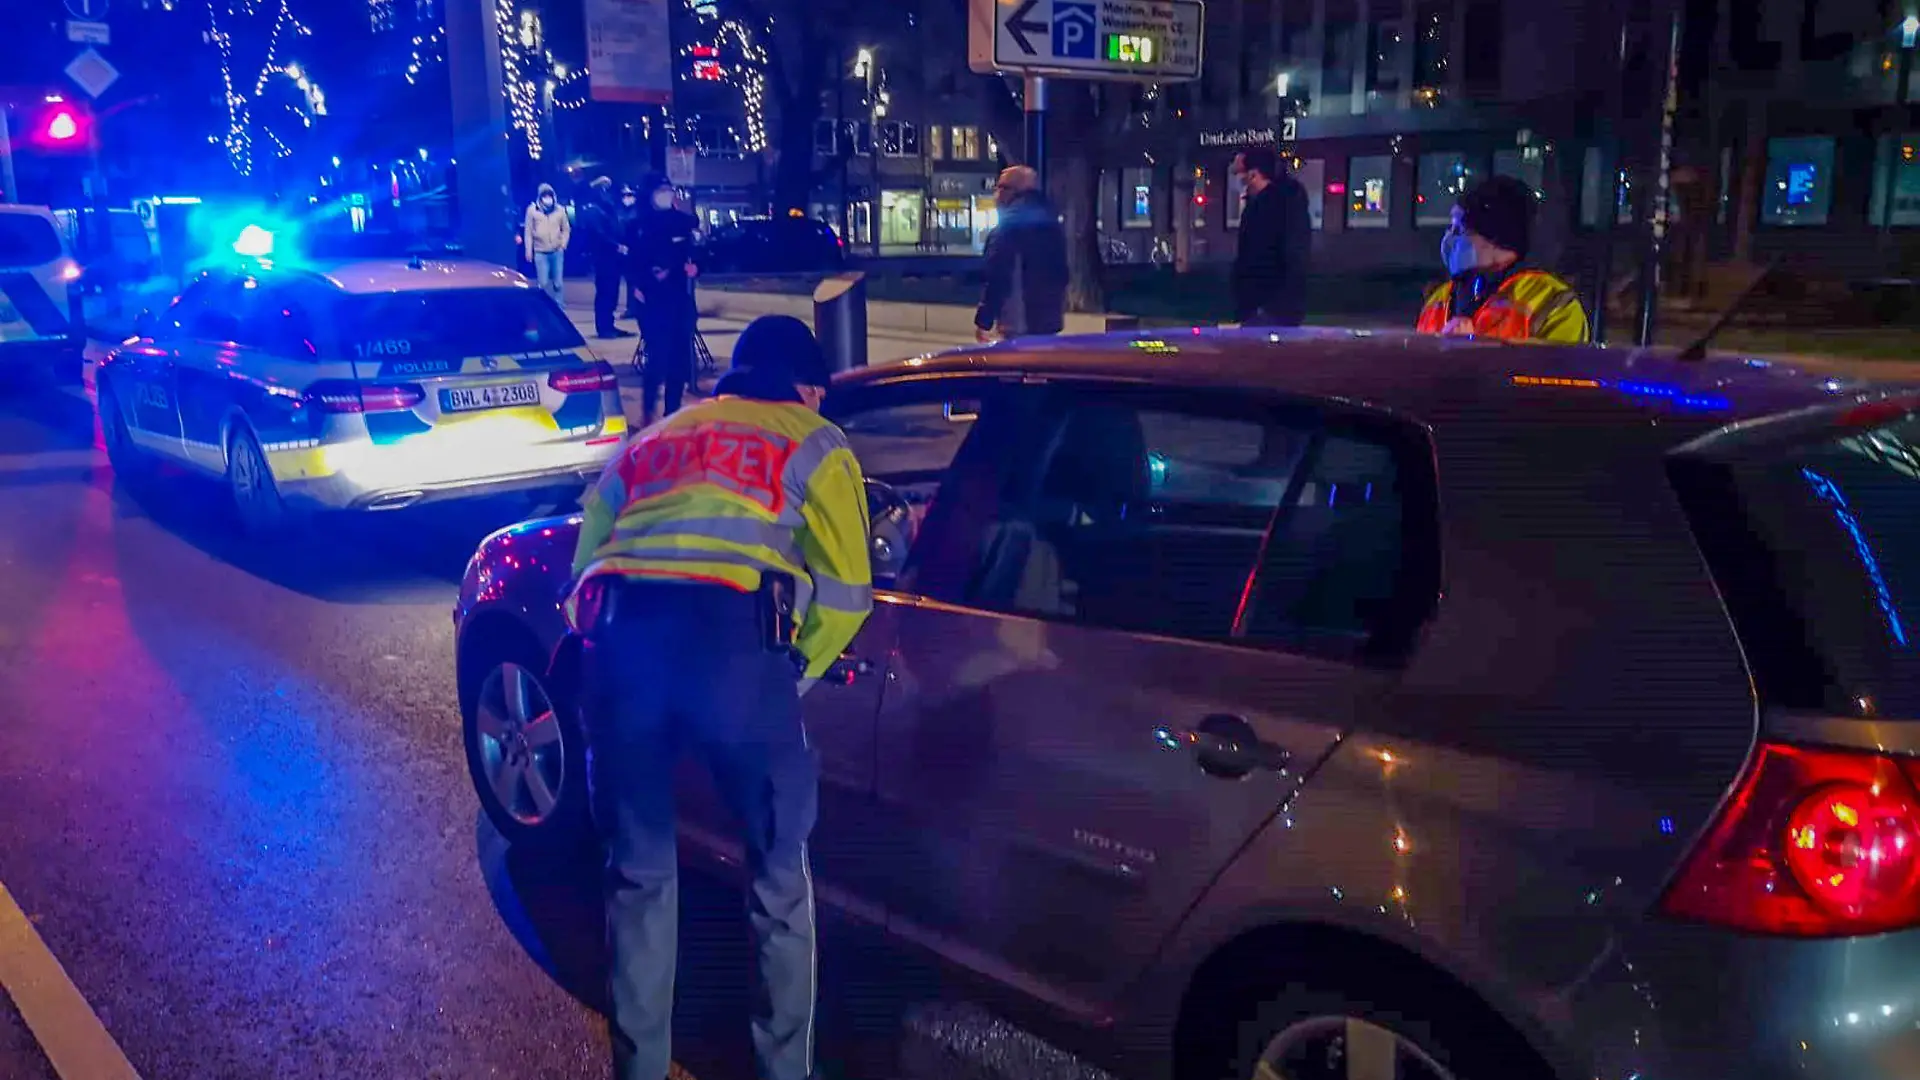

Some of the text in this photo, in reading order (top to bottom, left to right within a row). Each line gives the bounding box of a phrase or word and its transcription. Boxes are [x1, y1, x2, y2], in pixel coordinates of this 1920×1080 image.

[354, 339, 411, 358] 1/469
[393, 360, 449, 375] POLIZEI
[451, 390, 479, 407] BWL
[501, 384, 535, 402] 2308
[632, 435, 775, 486] POLIZEI
